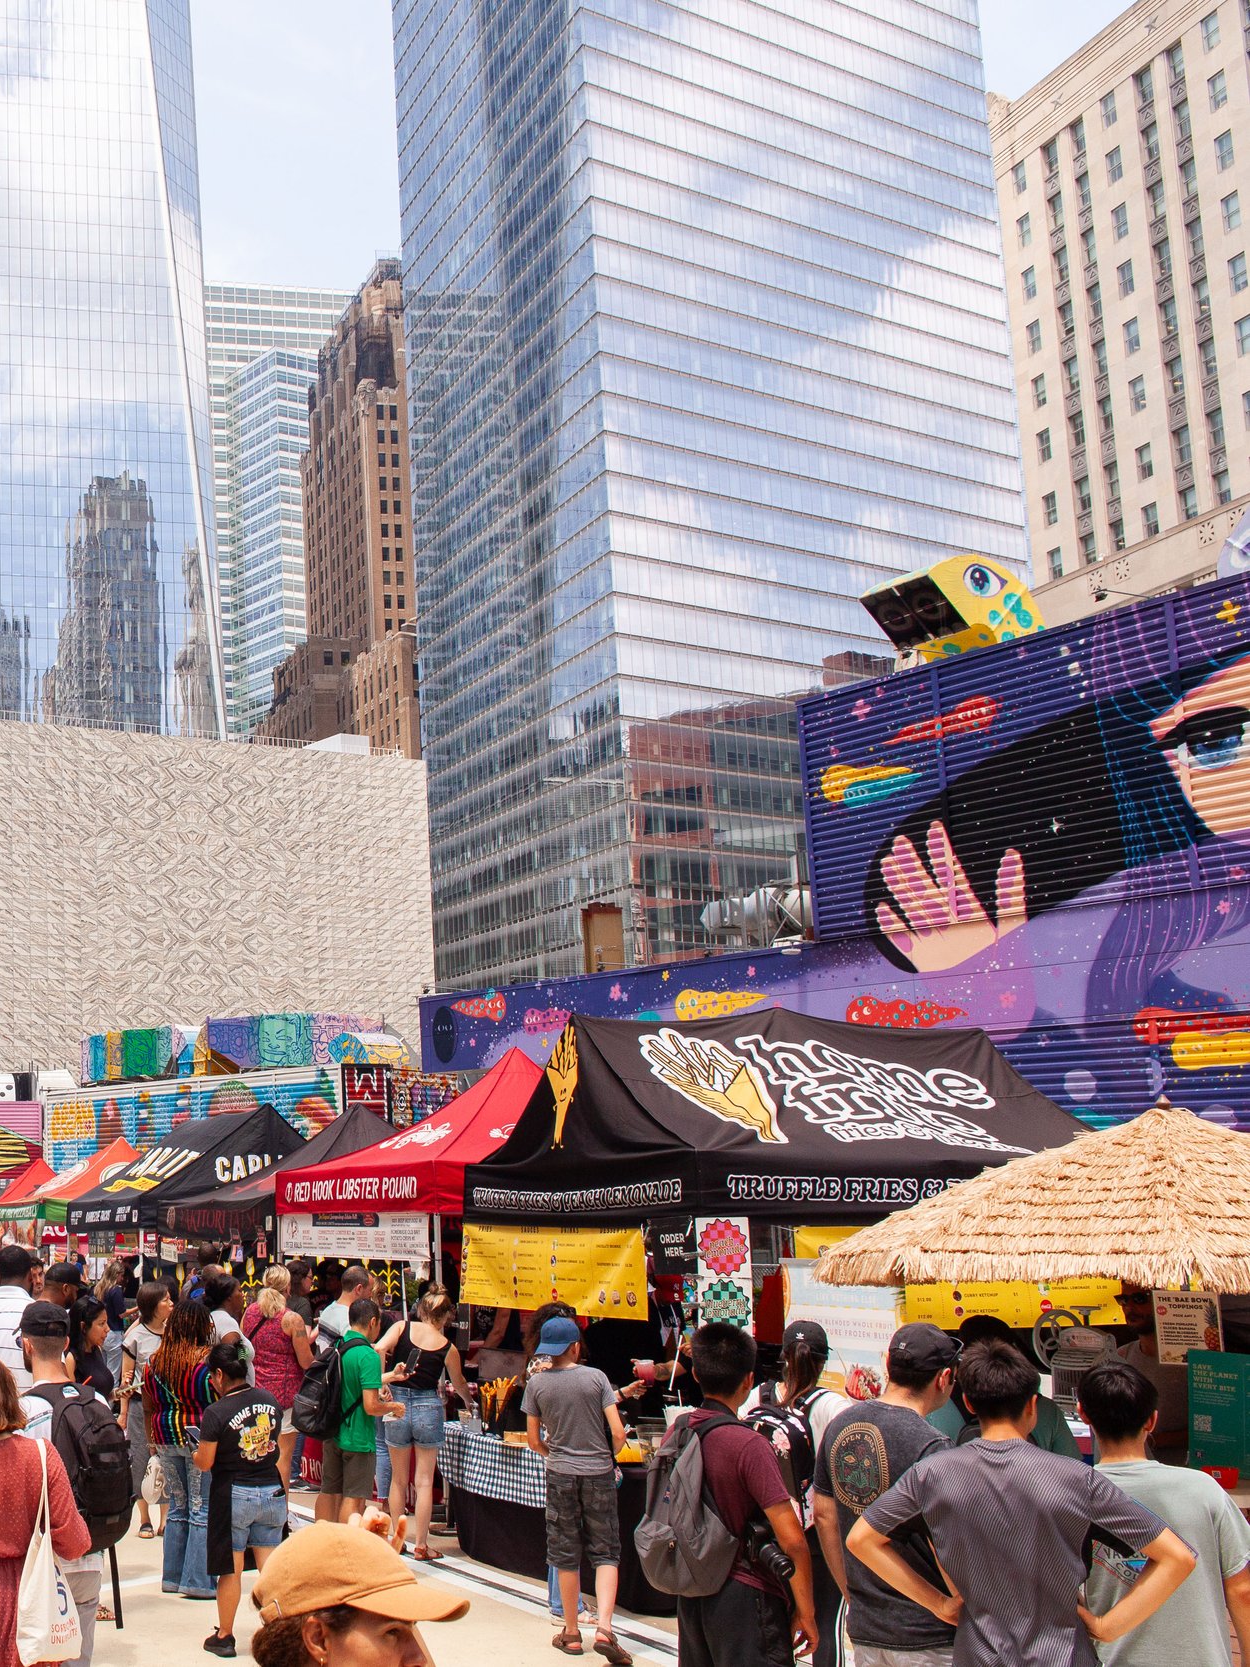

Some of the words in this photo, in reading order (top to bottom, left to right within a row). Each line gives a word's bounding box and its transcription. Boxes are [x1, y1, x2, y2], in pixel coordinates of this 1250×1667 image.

[735, 1034, 997, 1110] home
[823, 1122, 897, 1142] fries
[294, 1181, 310, 1203] RED
[312, 1179, 336, 1201] HOOK
[336, 1177, 380, 1200] LOBSTER
[382, 1176, 418, 1200] POUND
[473, 1187, 518, 1209] TRUFFLE
[519, 1191, 551, 1210] FRIES
[551, 1192, 563, 1211] &
[562, 1189, 606, 1211] PEACH
[606, 1178, 682, 1208] LEMONADE
[727, 1174, 841, 1201] TRUFFLE
[843, 1178, 918, 1202] FRIES
[920, 1179, 945, 1201] &
[660, 1233, 685, 1244] ORDER
[709, 1237, 735, 1250] peach
[664, 1247, 684, 1258] HERE
[704, 1246, 745, 1260] lemonade
[703, 1298, 746, 1310] blueberry
[705, 1308, 746, 1318] lemonade
[825, 1318, 850, 1327] BLENDED
[844, 1330, 871, 1338] FROZEN
[1210, 1371, 1239, 1380] PLANET
[1193, 1382, 1218, 1390] EVERY
[1219, 1385, 1236, 1393] BITE
[228, 1406, 252, 1430] HOME
[252, 1403, 276, 1416] FRITE
[841, 1433, 861, 1447] OPEN
